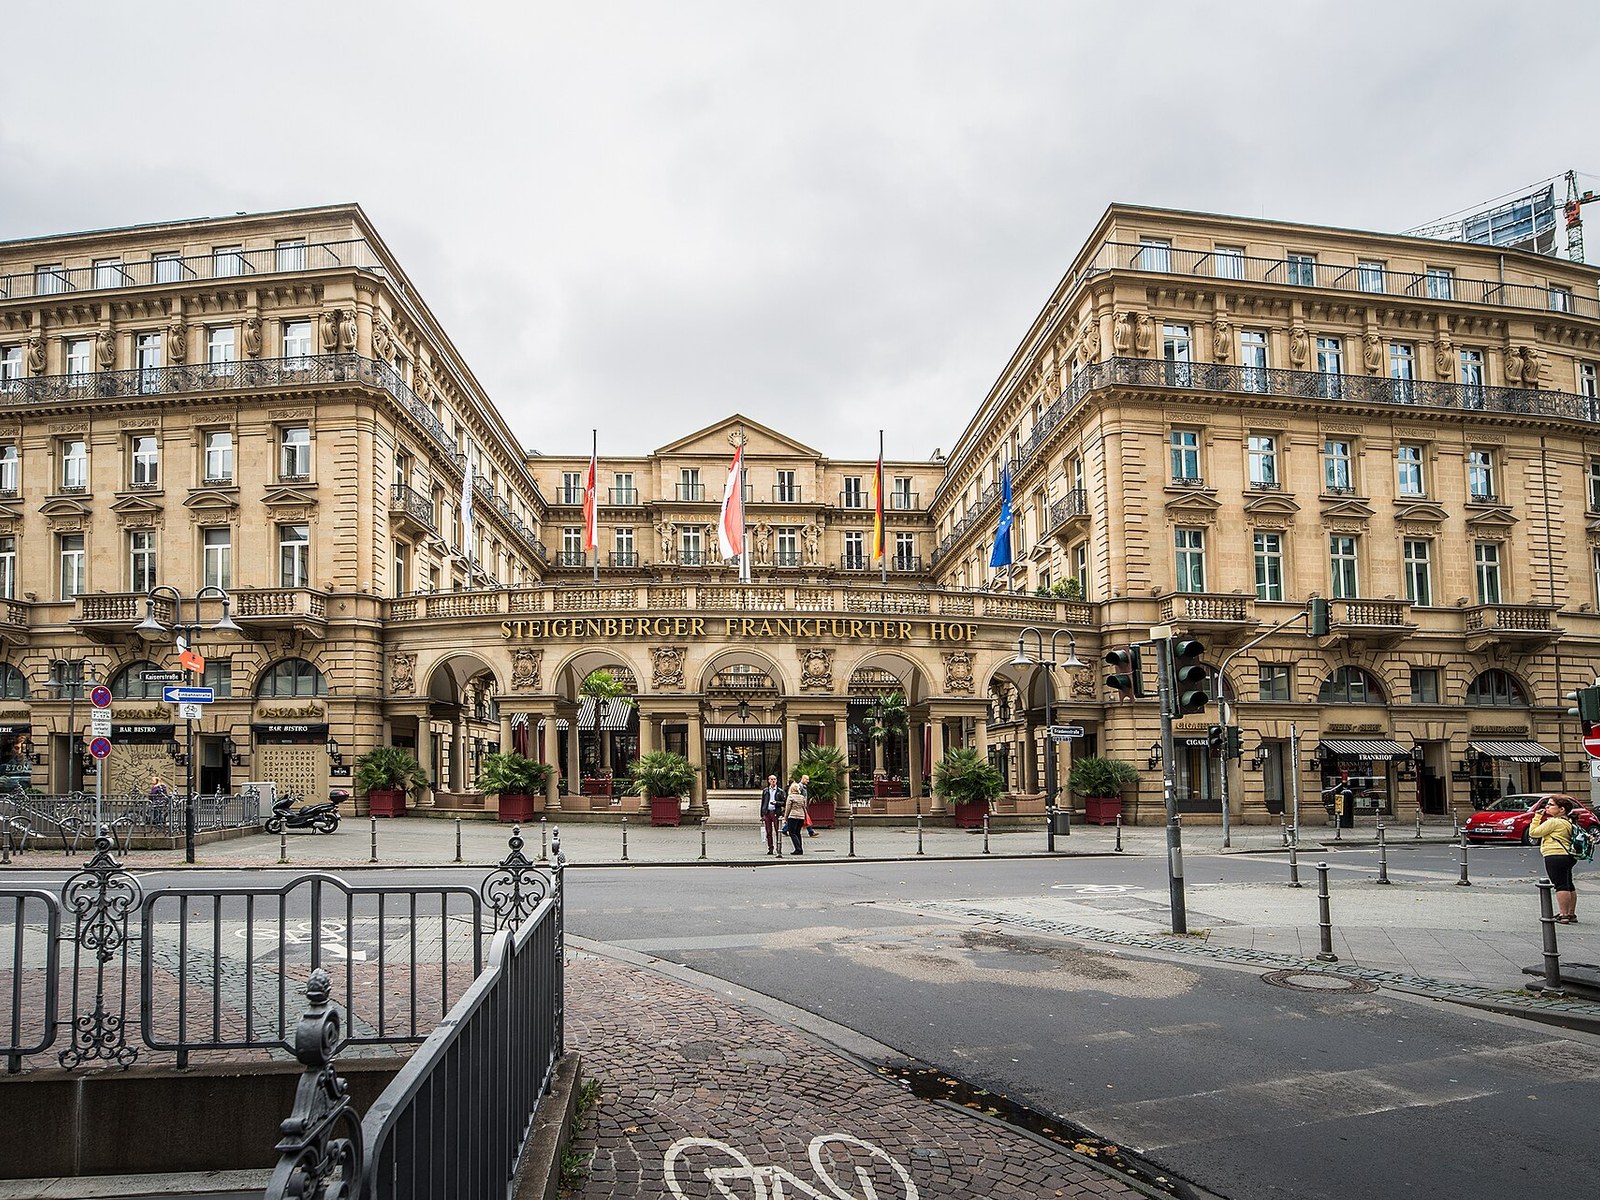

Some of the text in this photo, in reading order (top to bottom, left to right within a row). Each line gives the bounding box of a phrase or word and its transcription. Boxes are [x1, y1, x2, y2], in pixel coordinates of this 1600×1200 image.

[501, 617, 978, 641] STEIGENBERGER FRANKFURTER HOF
[256, 701, 324, 718] OSCAR'S
[5, 764, 29, 772] ETON
